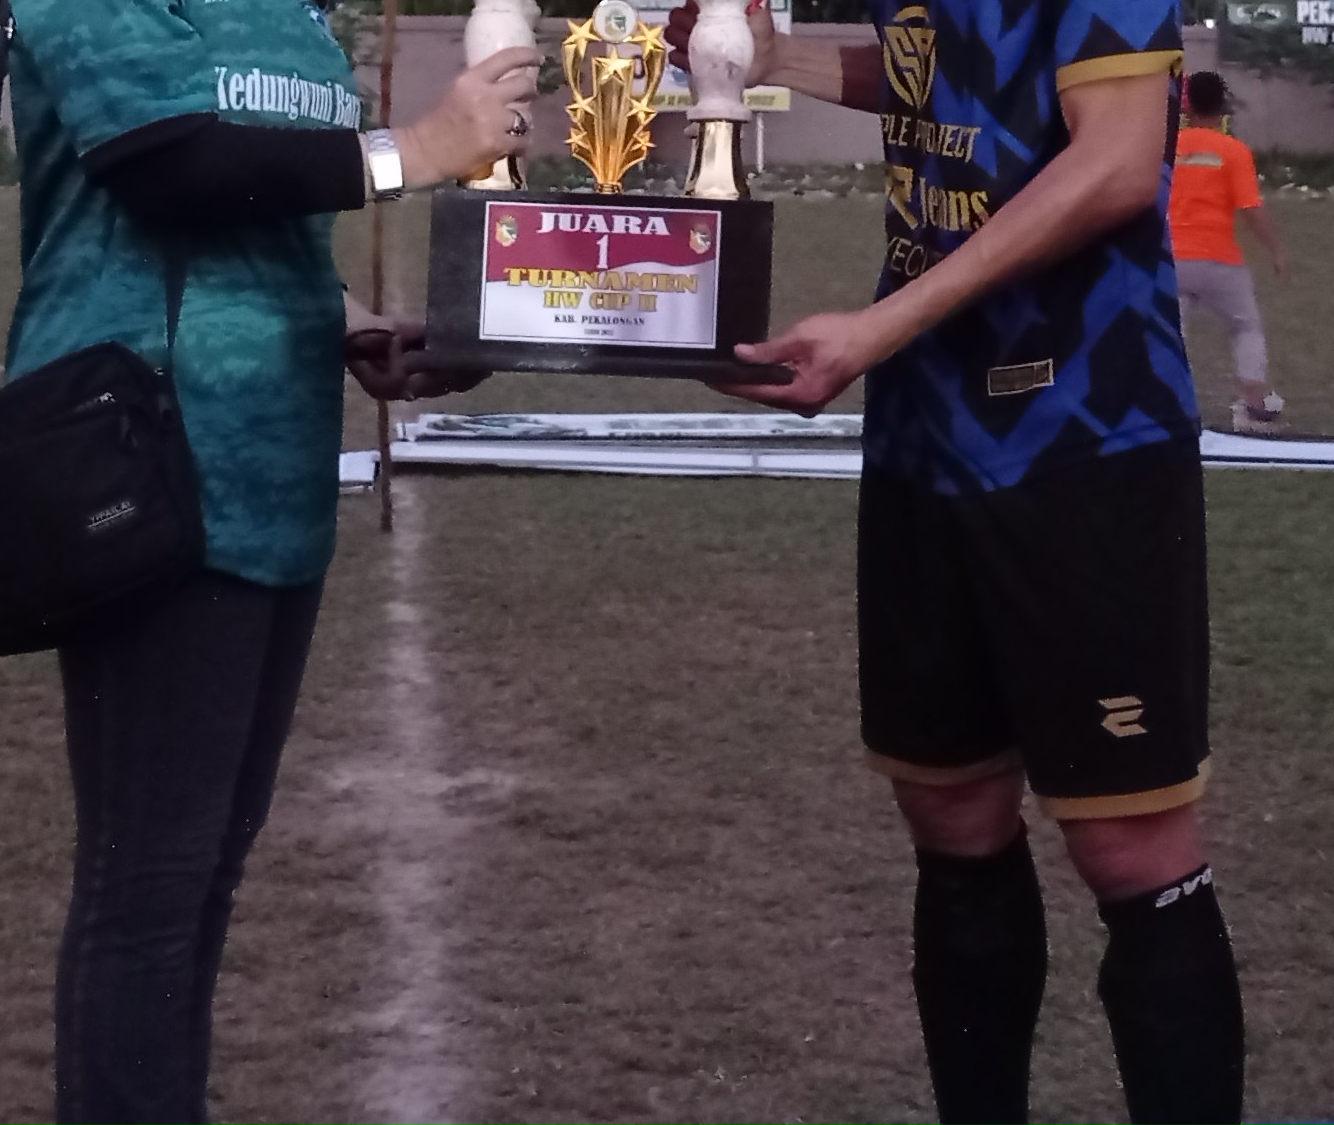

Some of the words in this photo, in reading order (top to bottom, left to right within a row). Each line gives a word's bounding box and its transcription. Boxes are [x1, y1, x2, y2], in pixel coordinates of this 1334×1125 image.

[537, 211, 670, 236] JUARA
[595, 234, 610, 269] 1
[503, 267, 700, 294] TURNAMEN
[542, 290, 583, 310] HW
[588, 292, 633, 312] CUP
[581, 315, 646, 326] PEKALONGAN
